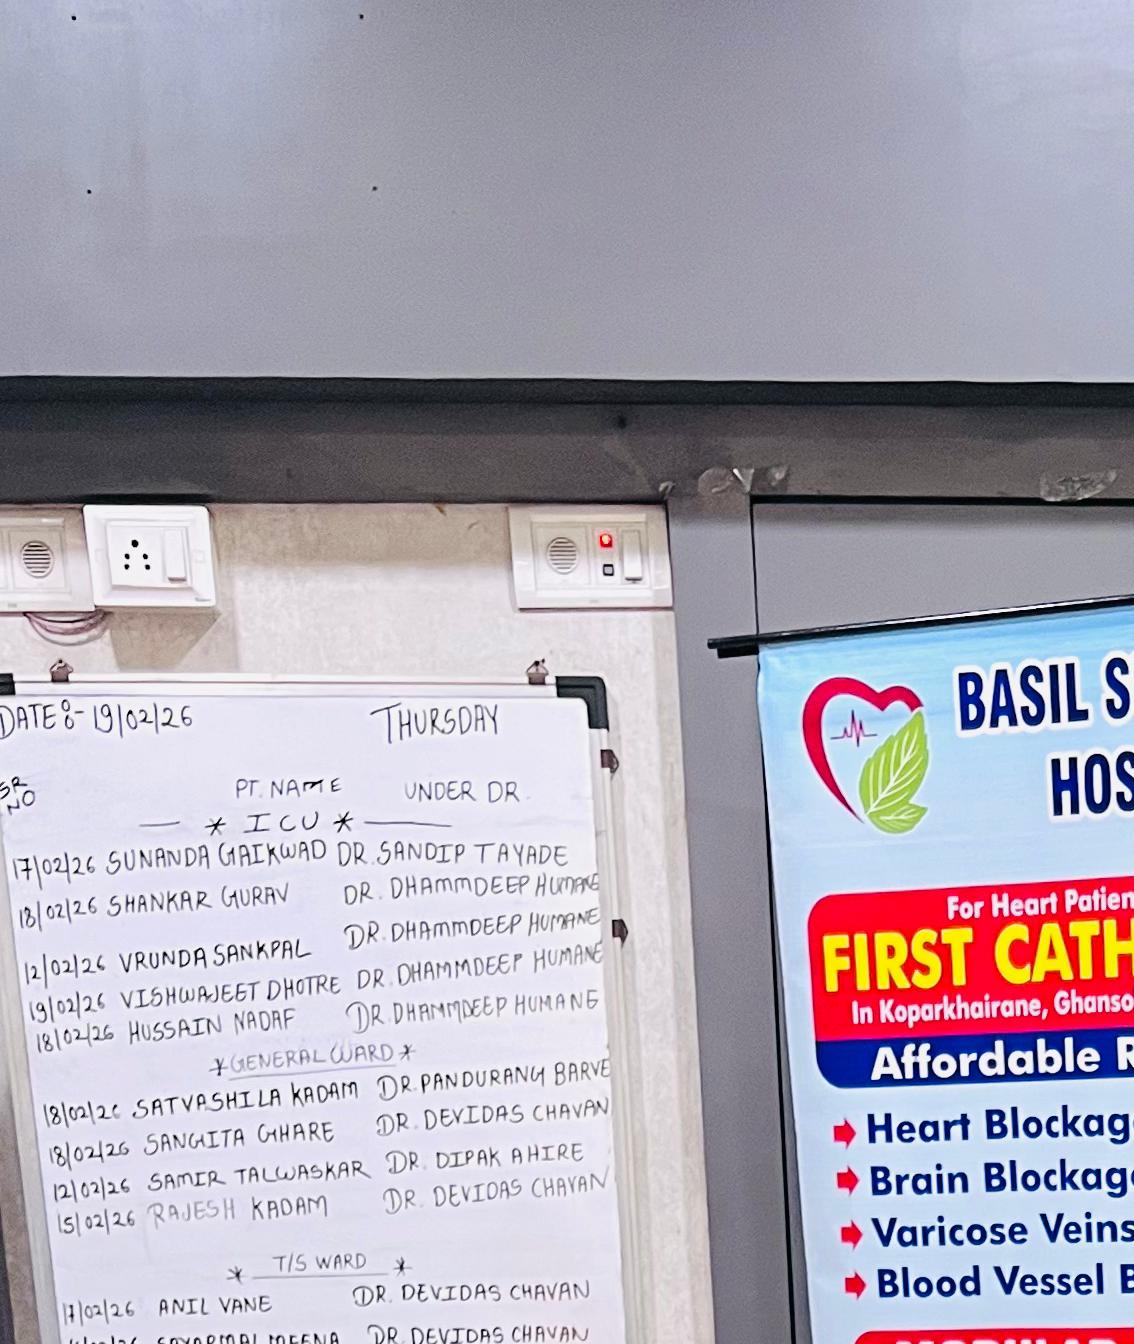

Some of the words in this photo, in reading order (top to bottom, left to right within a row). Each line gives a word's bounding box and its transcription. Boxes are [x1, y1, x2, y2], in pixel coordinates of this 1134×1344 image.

[958, 662, 1089, 731] BASIL
[370, 702, 500, 743] THURSDAY
[404, 781, 476, 802] UNDER
[106, 845, 210, 875] SUNANDA
[219, 839, 328, 868] GAIKWAD
[378, 842, 465, 866] SANDIP
[474, 843, 569, 867] TAYADE
[107, 889, 212, 917] SHANKAR
[946, 894, 984, 918] For
[990, 891, 1059, 916] Heart
[119, 945, 207, 974] VRUNDA
[213, 937, 312, 965] SANKPAL
[822, 928, 975, 993] FIRST
[266, 974, 341, 1002] DHOTRE
[129, 1017, 222, 1045] HUSSAIN
[234, 1008, 297, 1032] NADAF
[851, 1002, 872, 1024] In
[877, 993, 1049, 1029] Koparkhairane,
[870, 1038, 1101, 1081] Affordable
[291, 1081, 358, 1103] KADAM
[554, 1058, 611, 1084] BARVE
[144, 1130, 245, 1157] SANGITA
[258, 1121, 334, 1146] GHARE
[424, 1105, 522, 1131] DEVIDAS
[532, 1097, 609, 1122] CHAVAN
[867, 1111, 972, 1144] Heart
[147, 1168, 226, 1191] SAMIR
[234, 1160, 371, 1184] TALWASKAR
[436, 1146, 500, 1170] DIPAK
[510, 1143, 584, 1164] AHIRE
[869, 1164, 968, 1196] Brain
[148, 1199, 235, 1227] RAJESH
[251, 1194, 328, 1218] KADAM
[433, 1180, 522, 1207] DEVIDAS
[531, 1172, 608, 1197] CHAVAN
[871, 1216, 1029, 1249] Varicose
[315, 1252, 367, 1270] WARD
[159, 1299, 210, 1316] ANIL
[220, 1295, 272, 1314] VANE
[402, 1283, 501, 1302] DEVIDAS
[510, 1280, 590, 1300] CHAVAN
[878, 1266, 980, 1298] Blood
[993, 1263, 1104, 1297] Vessel
[511, 1324, 589, 1343] CHAVAN
